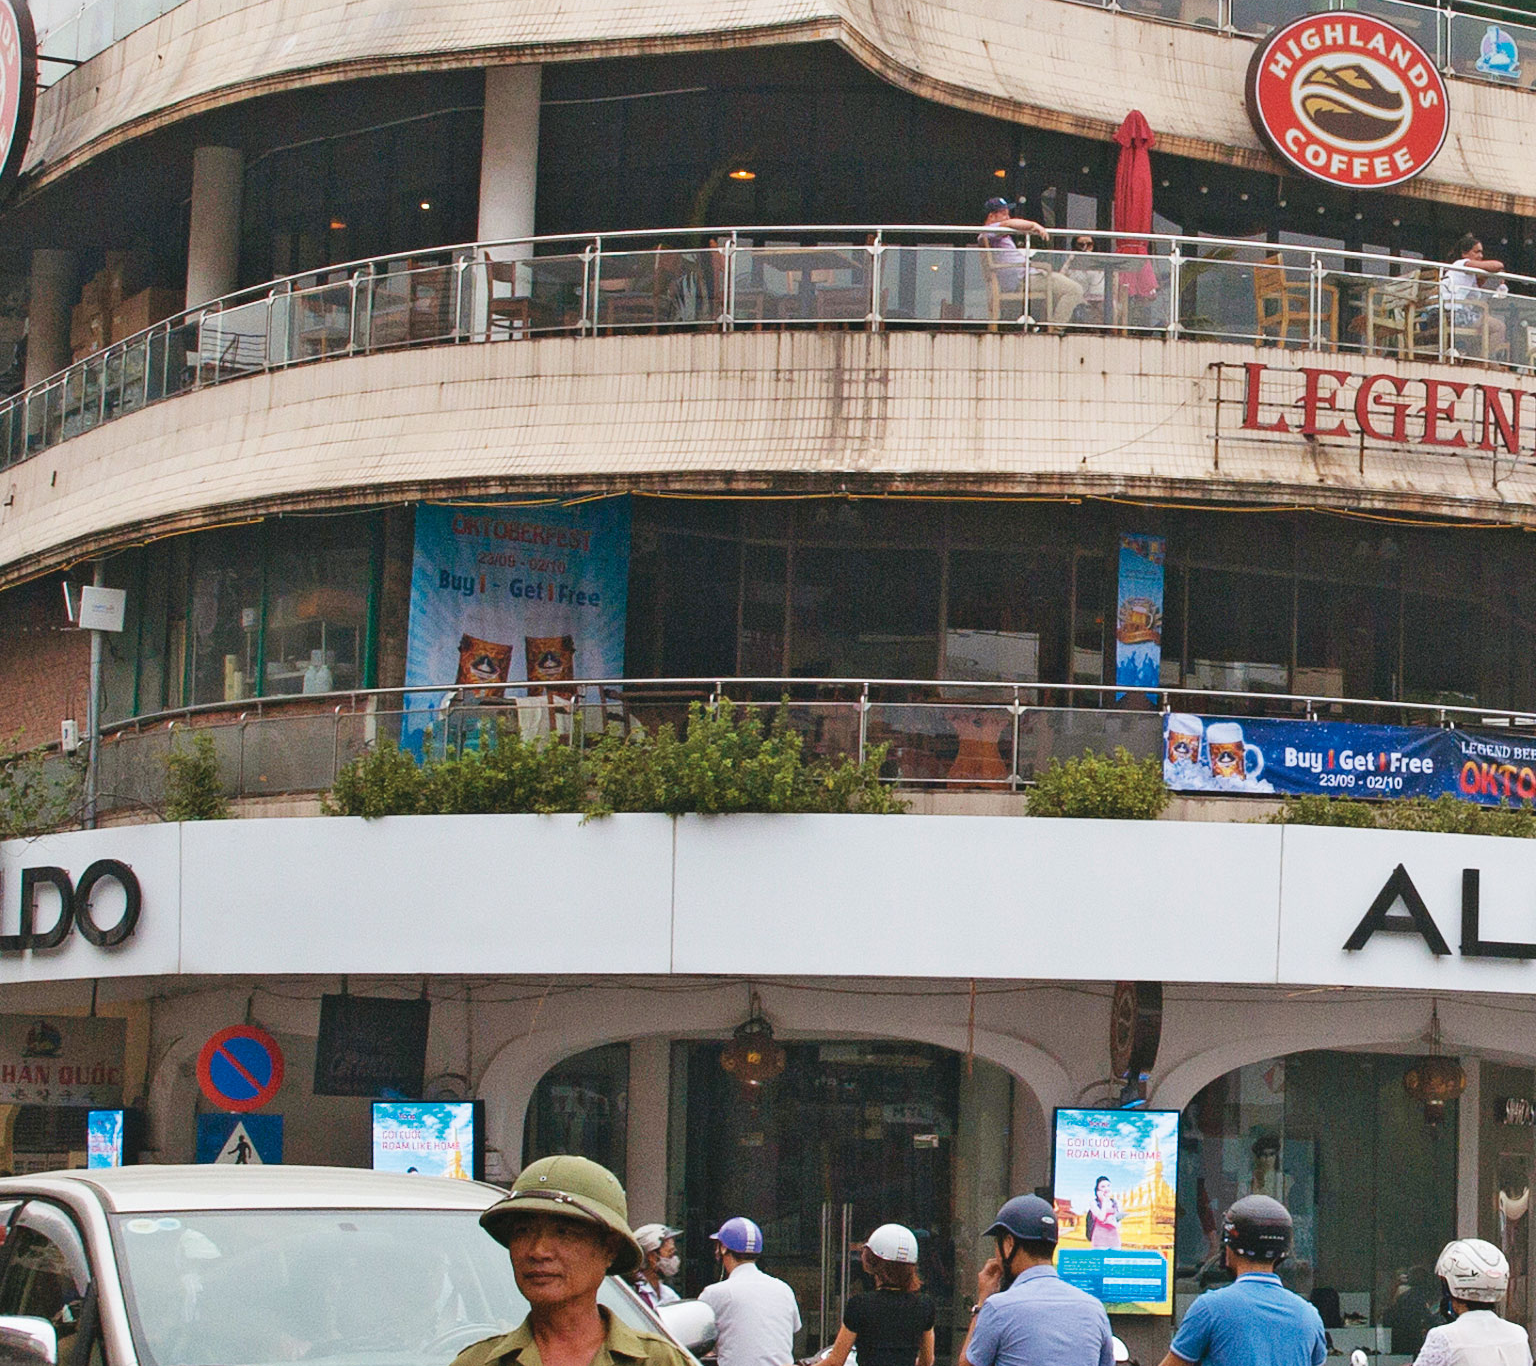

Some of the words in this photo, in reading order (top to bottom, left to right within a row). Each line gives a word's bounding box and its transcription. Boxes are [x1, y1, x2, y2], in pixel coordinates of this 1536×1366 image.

[1268, 23, 1438, 110] HIGHLANDS
[1284, 128, 1414, 179] COFFEE
[452, 514, 592, 552] OKTOBERFEST
[439, 570, 476, 597] Buy
[510, 579, 544, 601] Get
[558, 584, 602, 607] Free
[1284, 747, 1323, 773] Buy
[1339, 751, 1375, 772] Get
[1390, 753, 1434, 774] Free
[1461, 741, 1511, 759] LEGEND
[1319, 773, 1356, 788] 23/09
[1366, 775, 1403, 790] 02/10
[2, 1060, 50, 1084] HÀN
[382, 1141, 409, 1151] ROAM
[411, 1142, 432, 1151] LIKE
[434, 1142, 461, 1151] HOME
[1066, 1149, 1101, 1160] ROAM
[1103, 1150, 1126, 1160] LIKE
[1130, 1150, 1163, 1161] HOME
